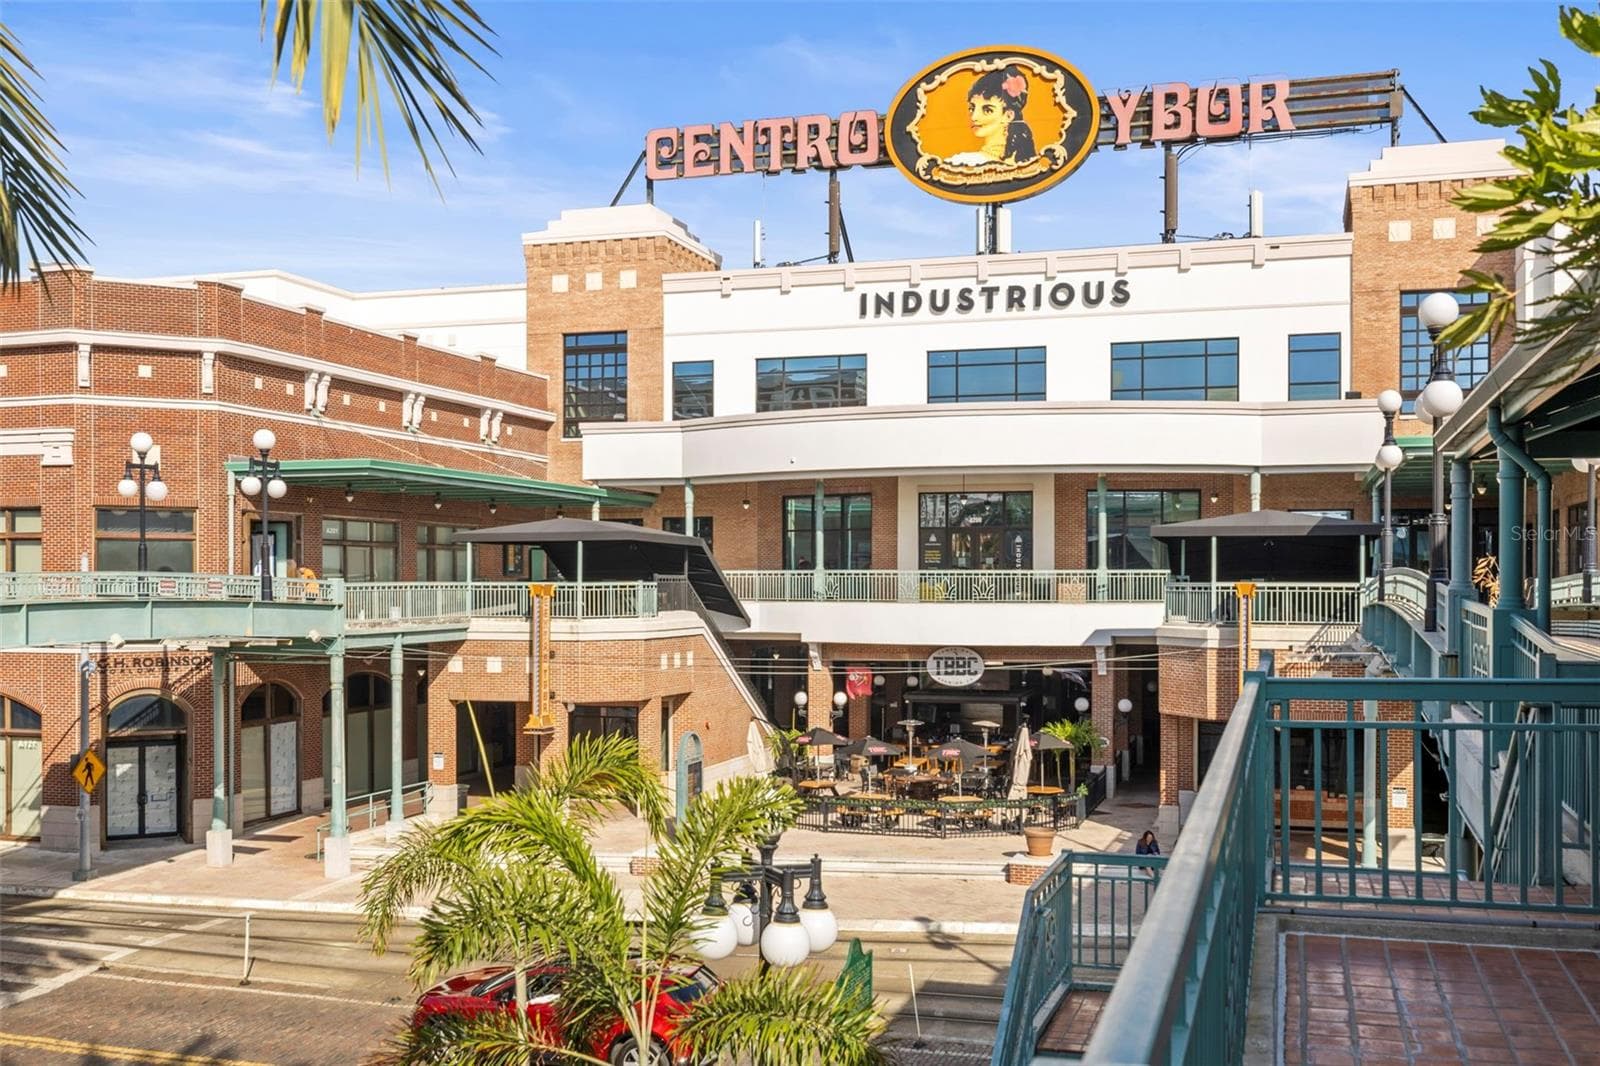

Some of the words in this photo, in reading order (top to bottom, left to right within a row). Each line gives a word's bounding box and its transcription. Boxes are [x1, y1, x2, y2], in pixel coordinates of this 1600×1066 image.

[646, 109, 880, 181] CENTRO
[1102, 73, 1297, 145] YBOR
[859, 279, 1131, 318] INDUSTRIOUS
[133, 656, 213, 668] ROBINSON
[933, 656, 978, 676] TBBC
